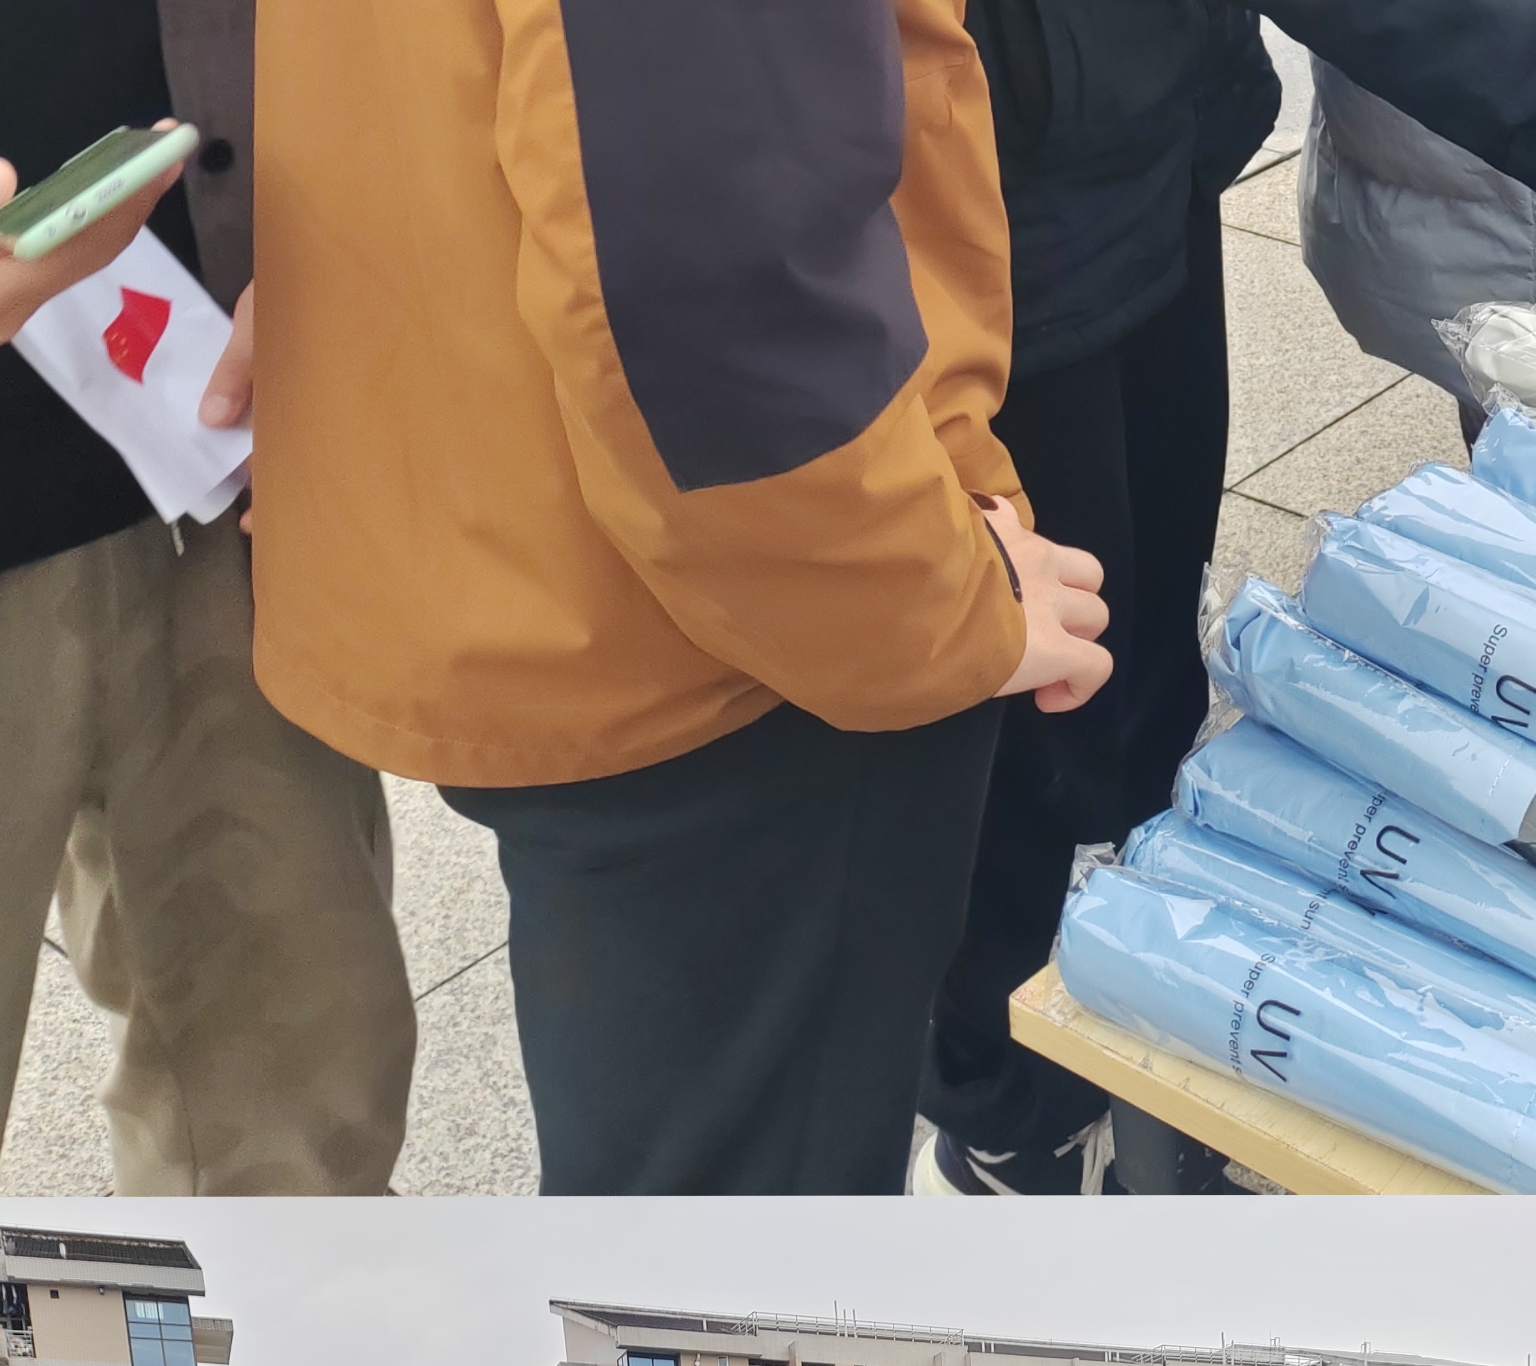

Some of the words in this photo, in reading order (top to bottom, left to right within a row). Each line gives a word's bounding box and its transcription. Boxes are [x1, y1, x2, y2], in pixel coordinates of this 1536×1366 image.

[1478, 623, 1508, 674] Super
[1470, 672, 1485, 714] preve
[1336, 822, 1367, 884] prevent
[1359, 824, 1421, 900] UV
[1299, 899, 1321, 931] sun
[1243, 952, 1277, 999] Super
[1228, 999, 1246, 1068] prevent
[1250, 998, 1302, 1083] UV
